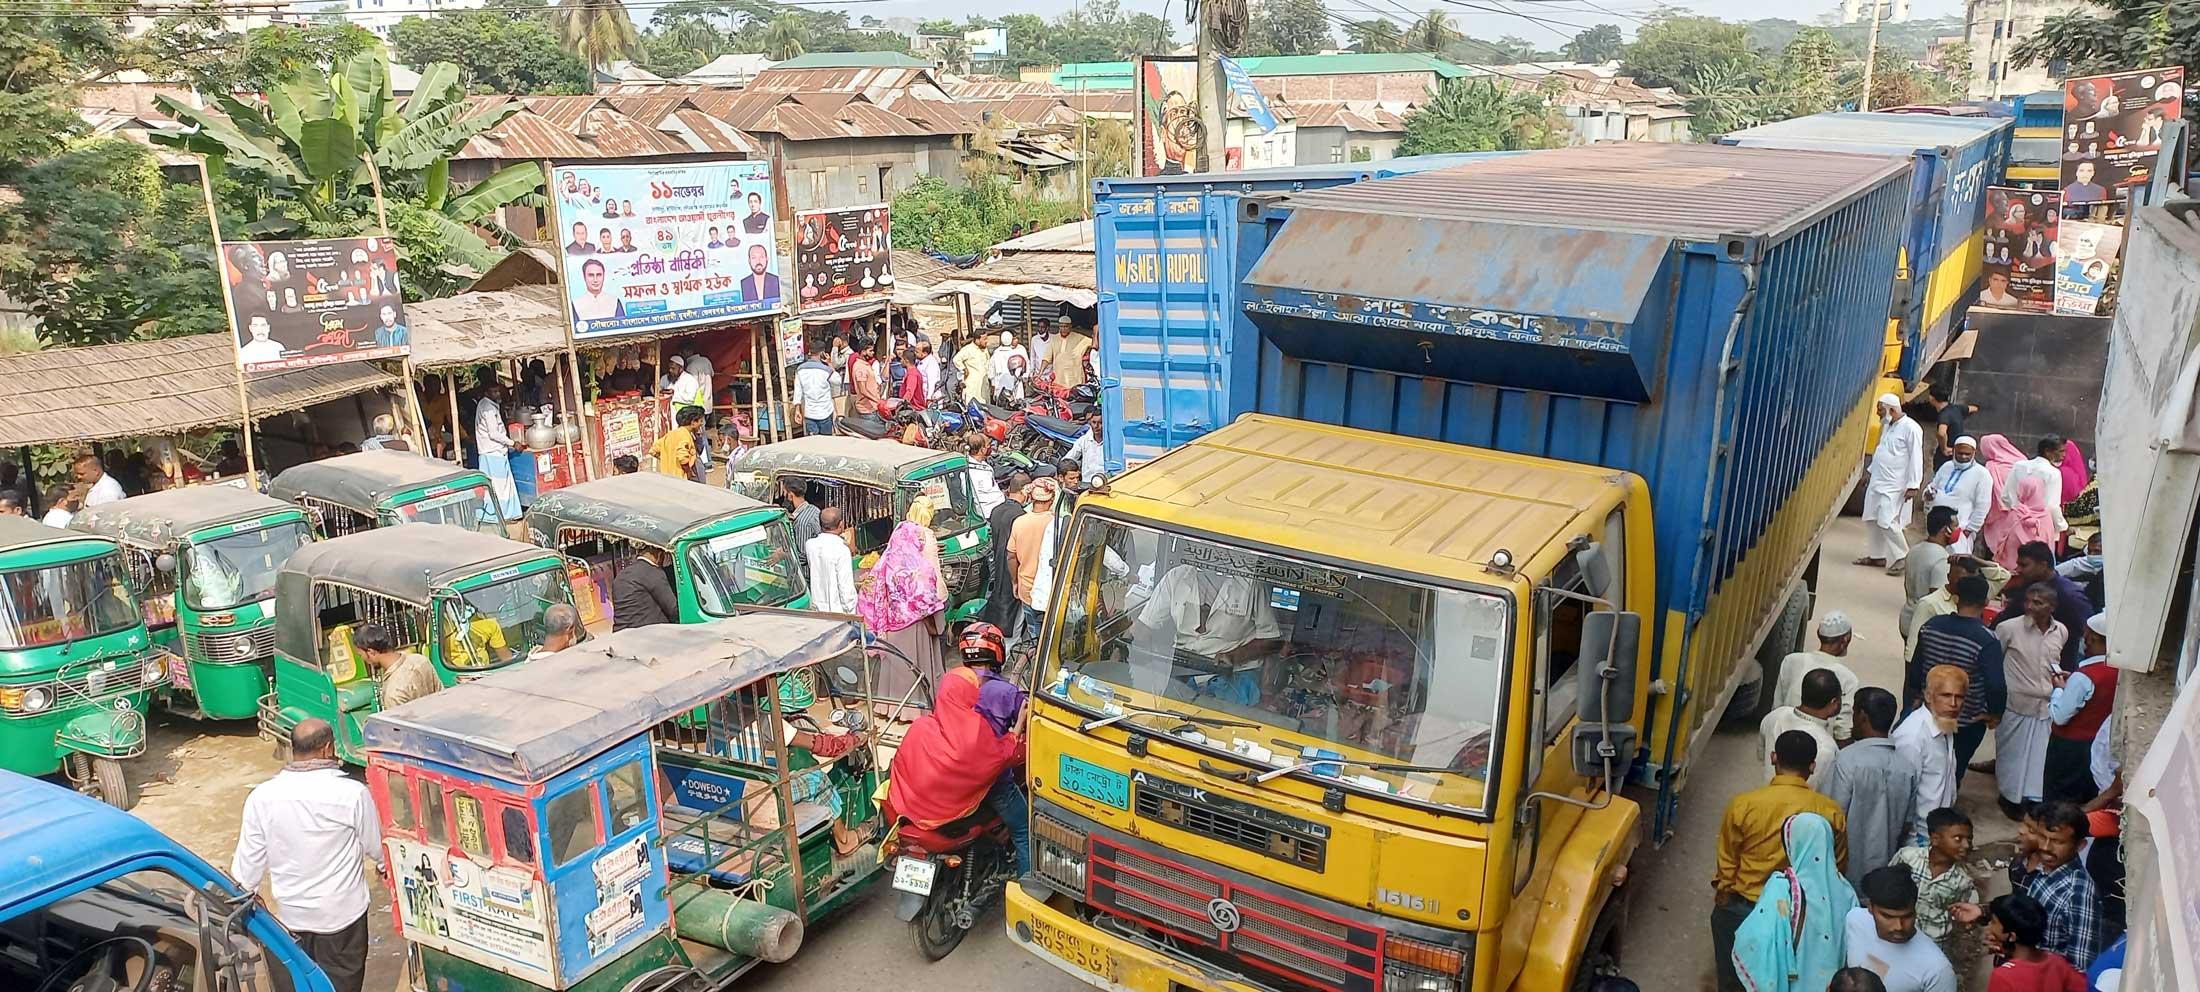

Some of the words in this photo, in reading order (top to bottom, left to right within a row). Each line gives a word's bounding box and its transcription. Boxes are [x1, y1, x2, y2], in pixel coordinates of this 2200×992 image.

[650, 181, 673, 199] ১১
[672, 185, 705, 198] নভেম্বর
[657, 230, 673, 241] ৪৯
[630, 253, 665, 277] প্রতিষ্ঠা
[669, 249, 706, 272] বার্ষিকী
[1166, 253, 1208, 284] RUPALI
[622, 282, 657, 299] সফল
[660, 284, 670, 296] ও
[704, 273, 733, 291] হউক
[688, 780, 723, 795] DOWEDO
[452, 889, 484, 912] FIRST
[1377, 887, 1425, 911] 1616
